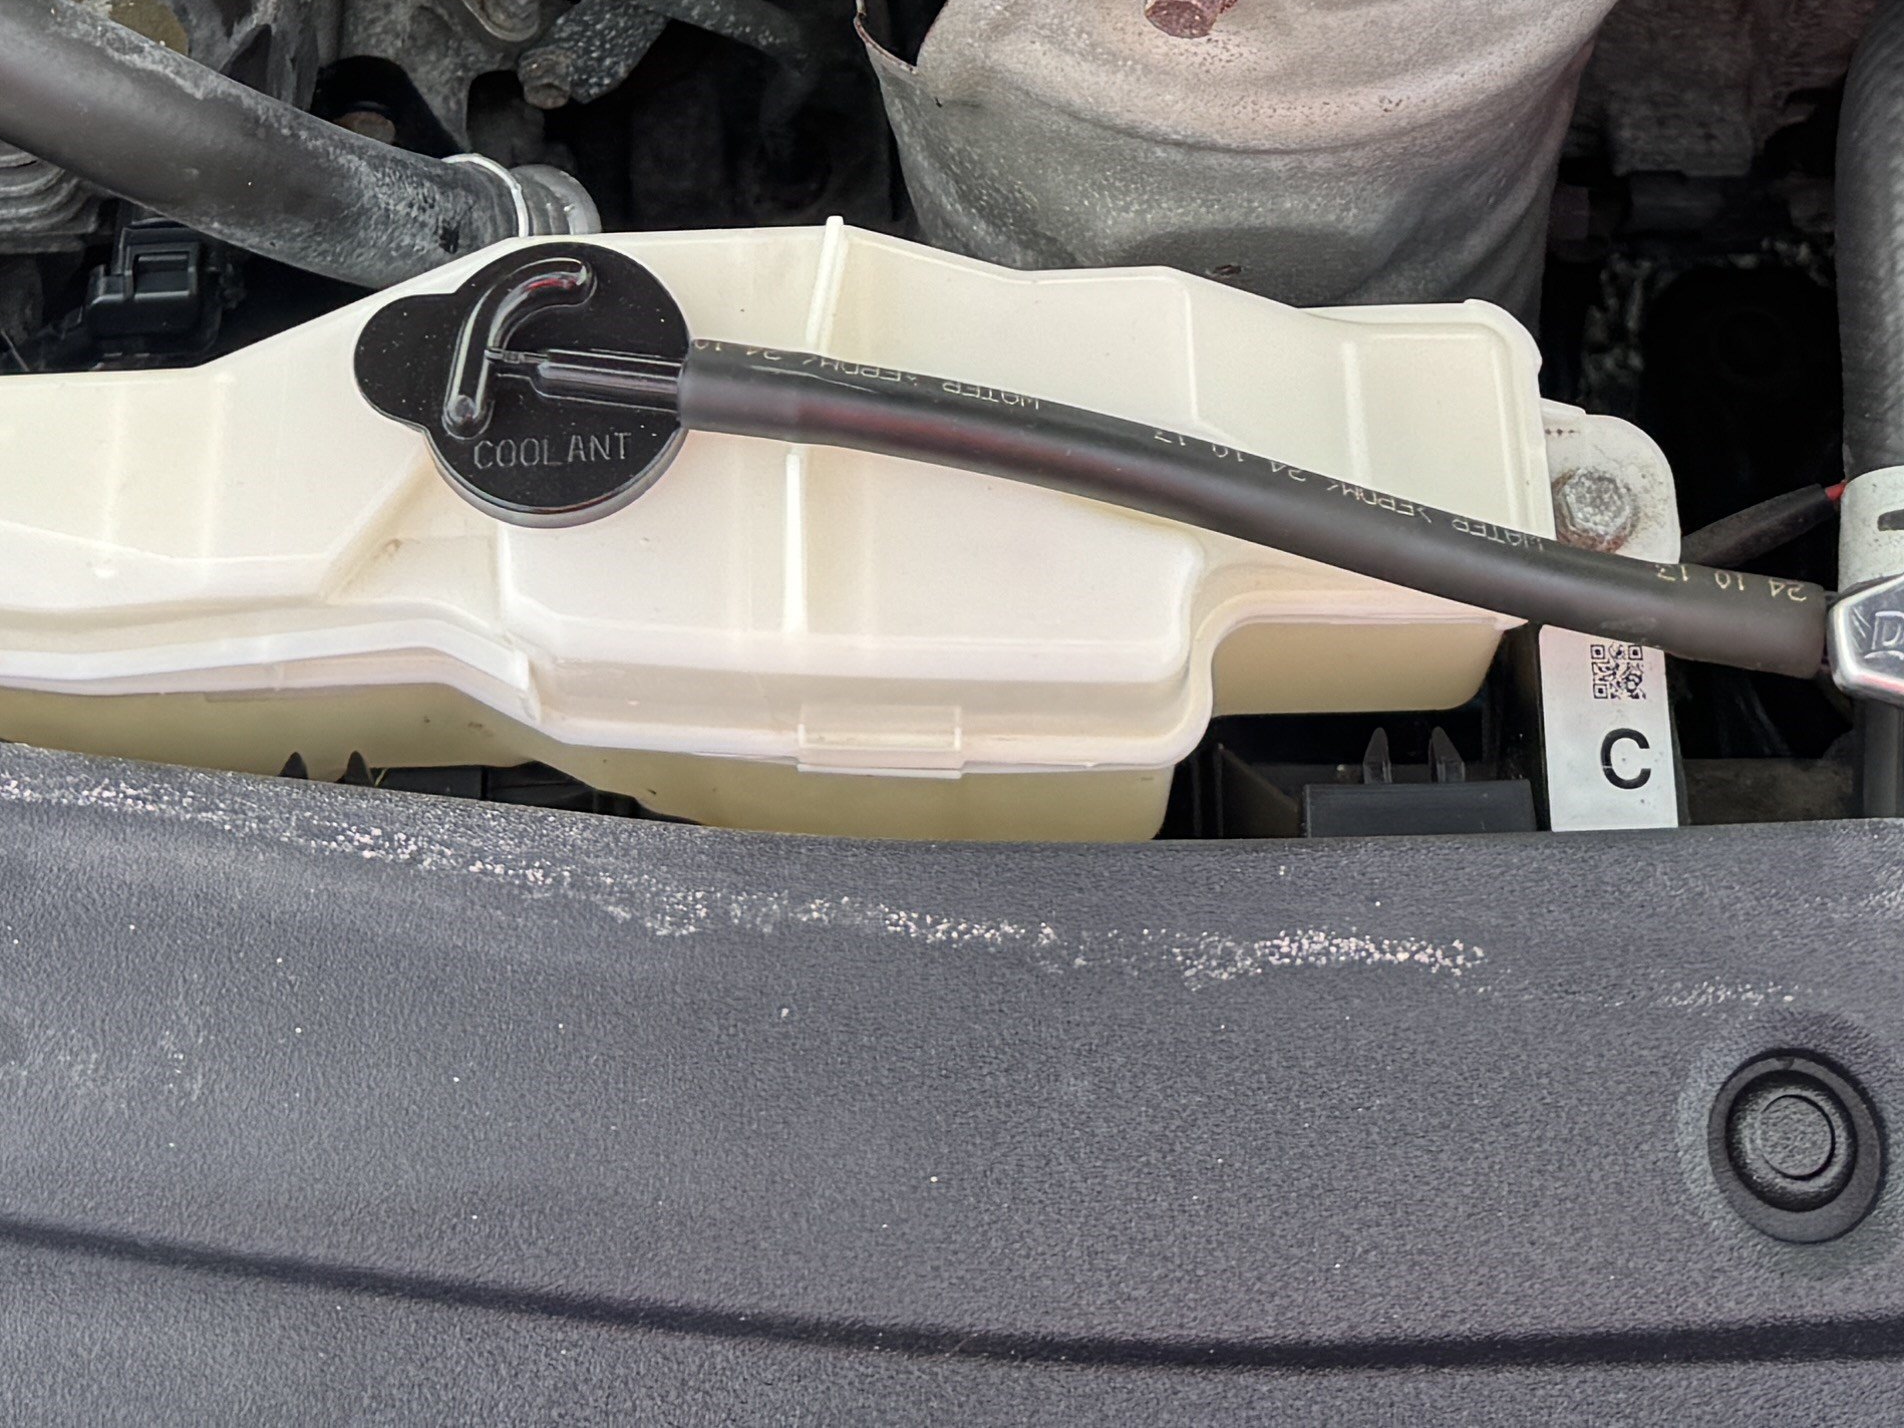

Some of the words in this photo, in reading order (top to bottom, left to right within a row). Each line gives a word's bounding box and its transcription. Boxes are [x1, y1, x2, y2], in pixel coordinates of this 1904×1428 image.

[473, 432, 632, 470] COOLANT
[1714, 570, 1745, 591] 10
[1600, 727, 1652, 790] C
